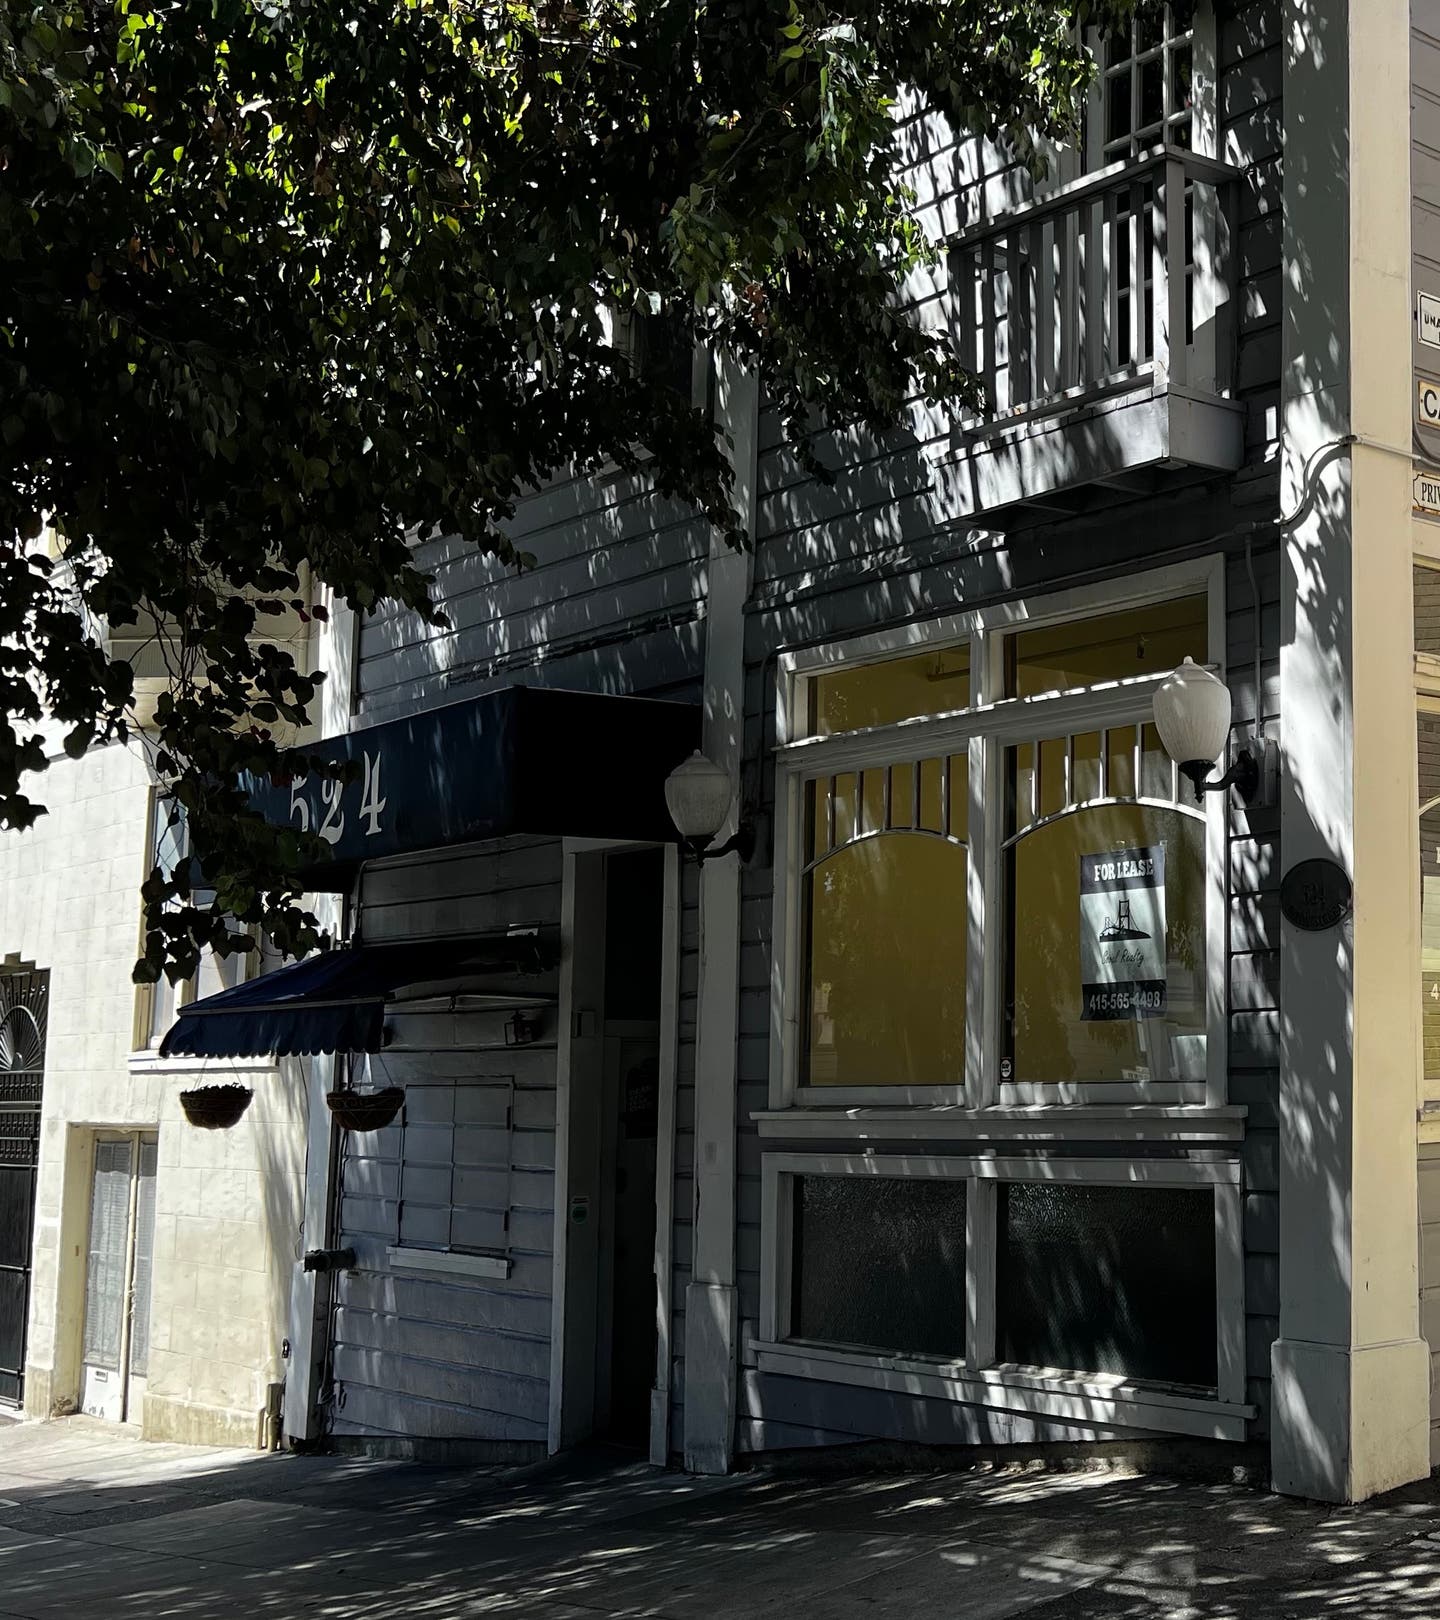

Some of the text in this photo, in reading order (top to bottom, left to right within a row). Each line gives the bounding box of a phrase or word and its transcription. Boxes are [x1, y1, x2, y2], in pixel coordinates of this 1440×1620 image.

[1094, 859, 1153, 881] FOR LEASE
[1121, 949, 1144, 967] Realty
